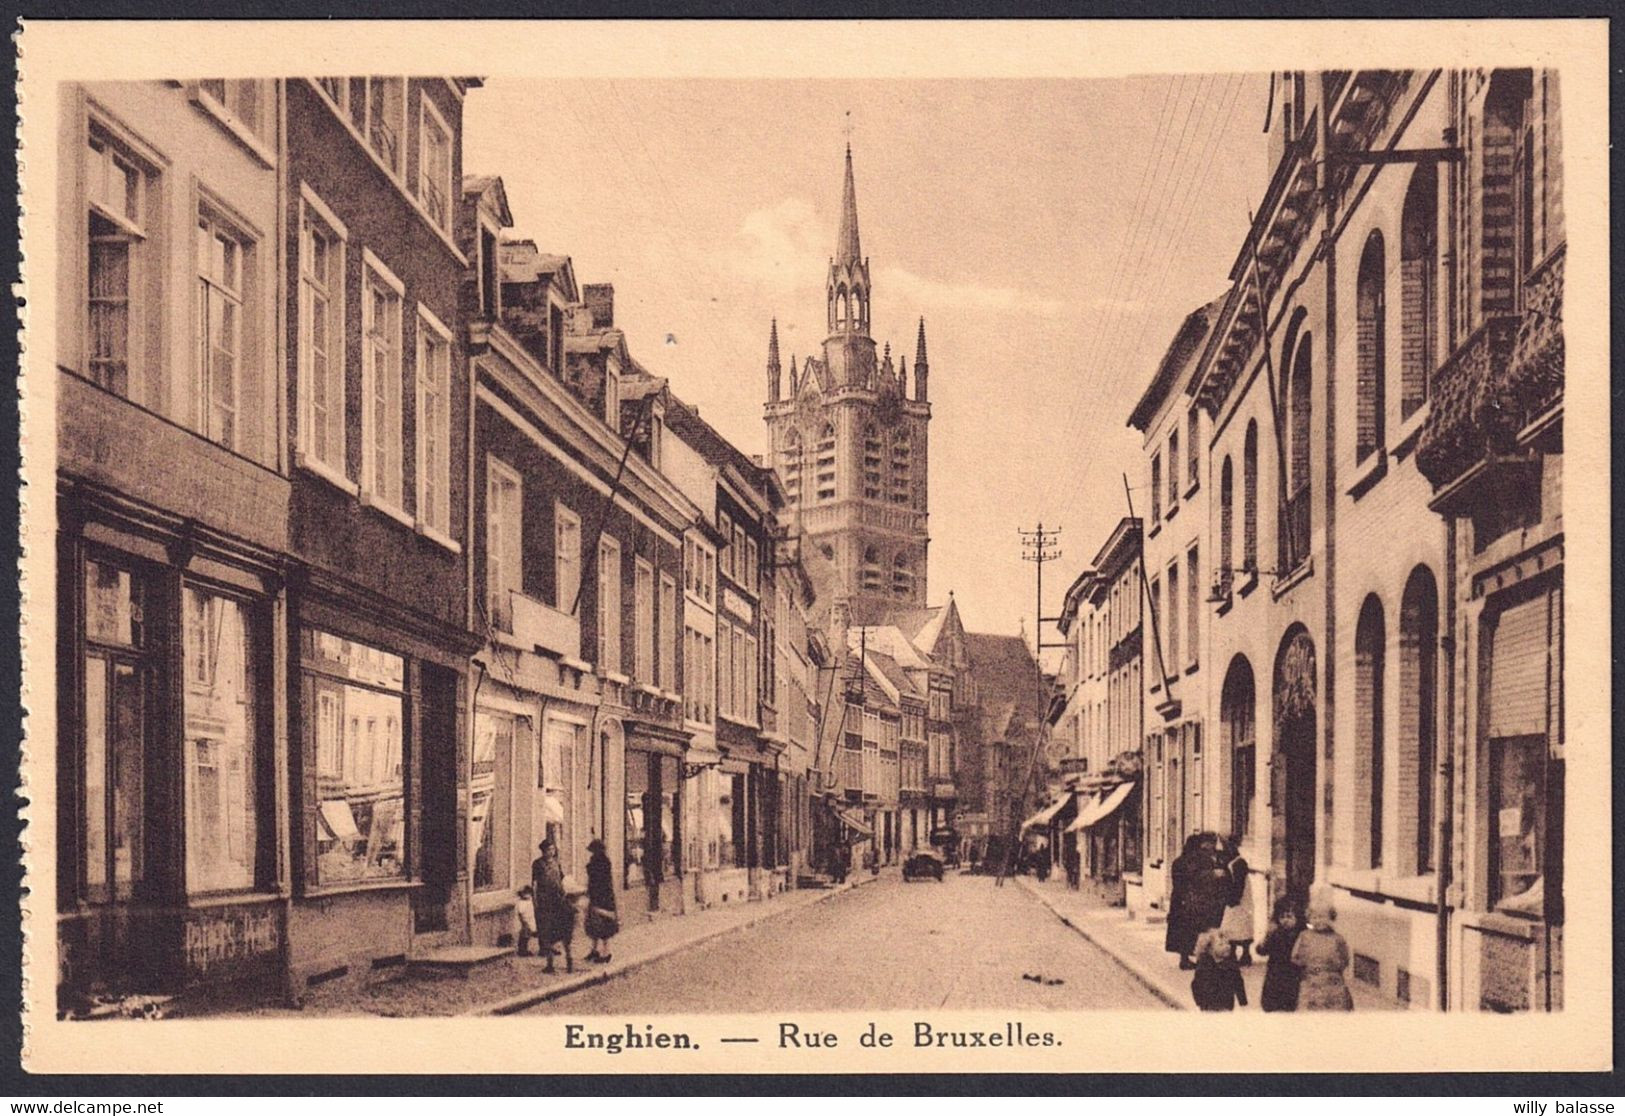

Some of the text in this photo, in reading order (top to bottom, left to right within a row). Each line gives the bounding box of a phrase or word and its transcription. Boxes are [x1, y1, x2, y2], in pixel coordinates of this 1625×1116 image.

[564, 1023, 700, 1055] Enghien.
[779, 1022, 838, 1049] Rue
[859, 1022, 893, 1048] de
[914, 1022, 1063, 1048] Bruxelles.
